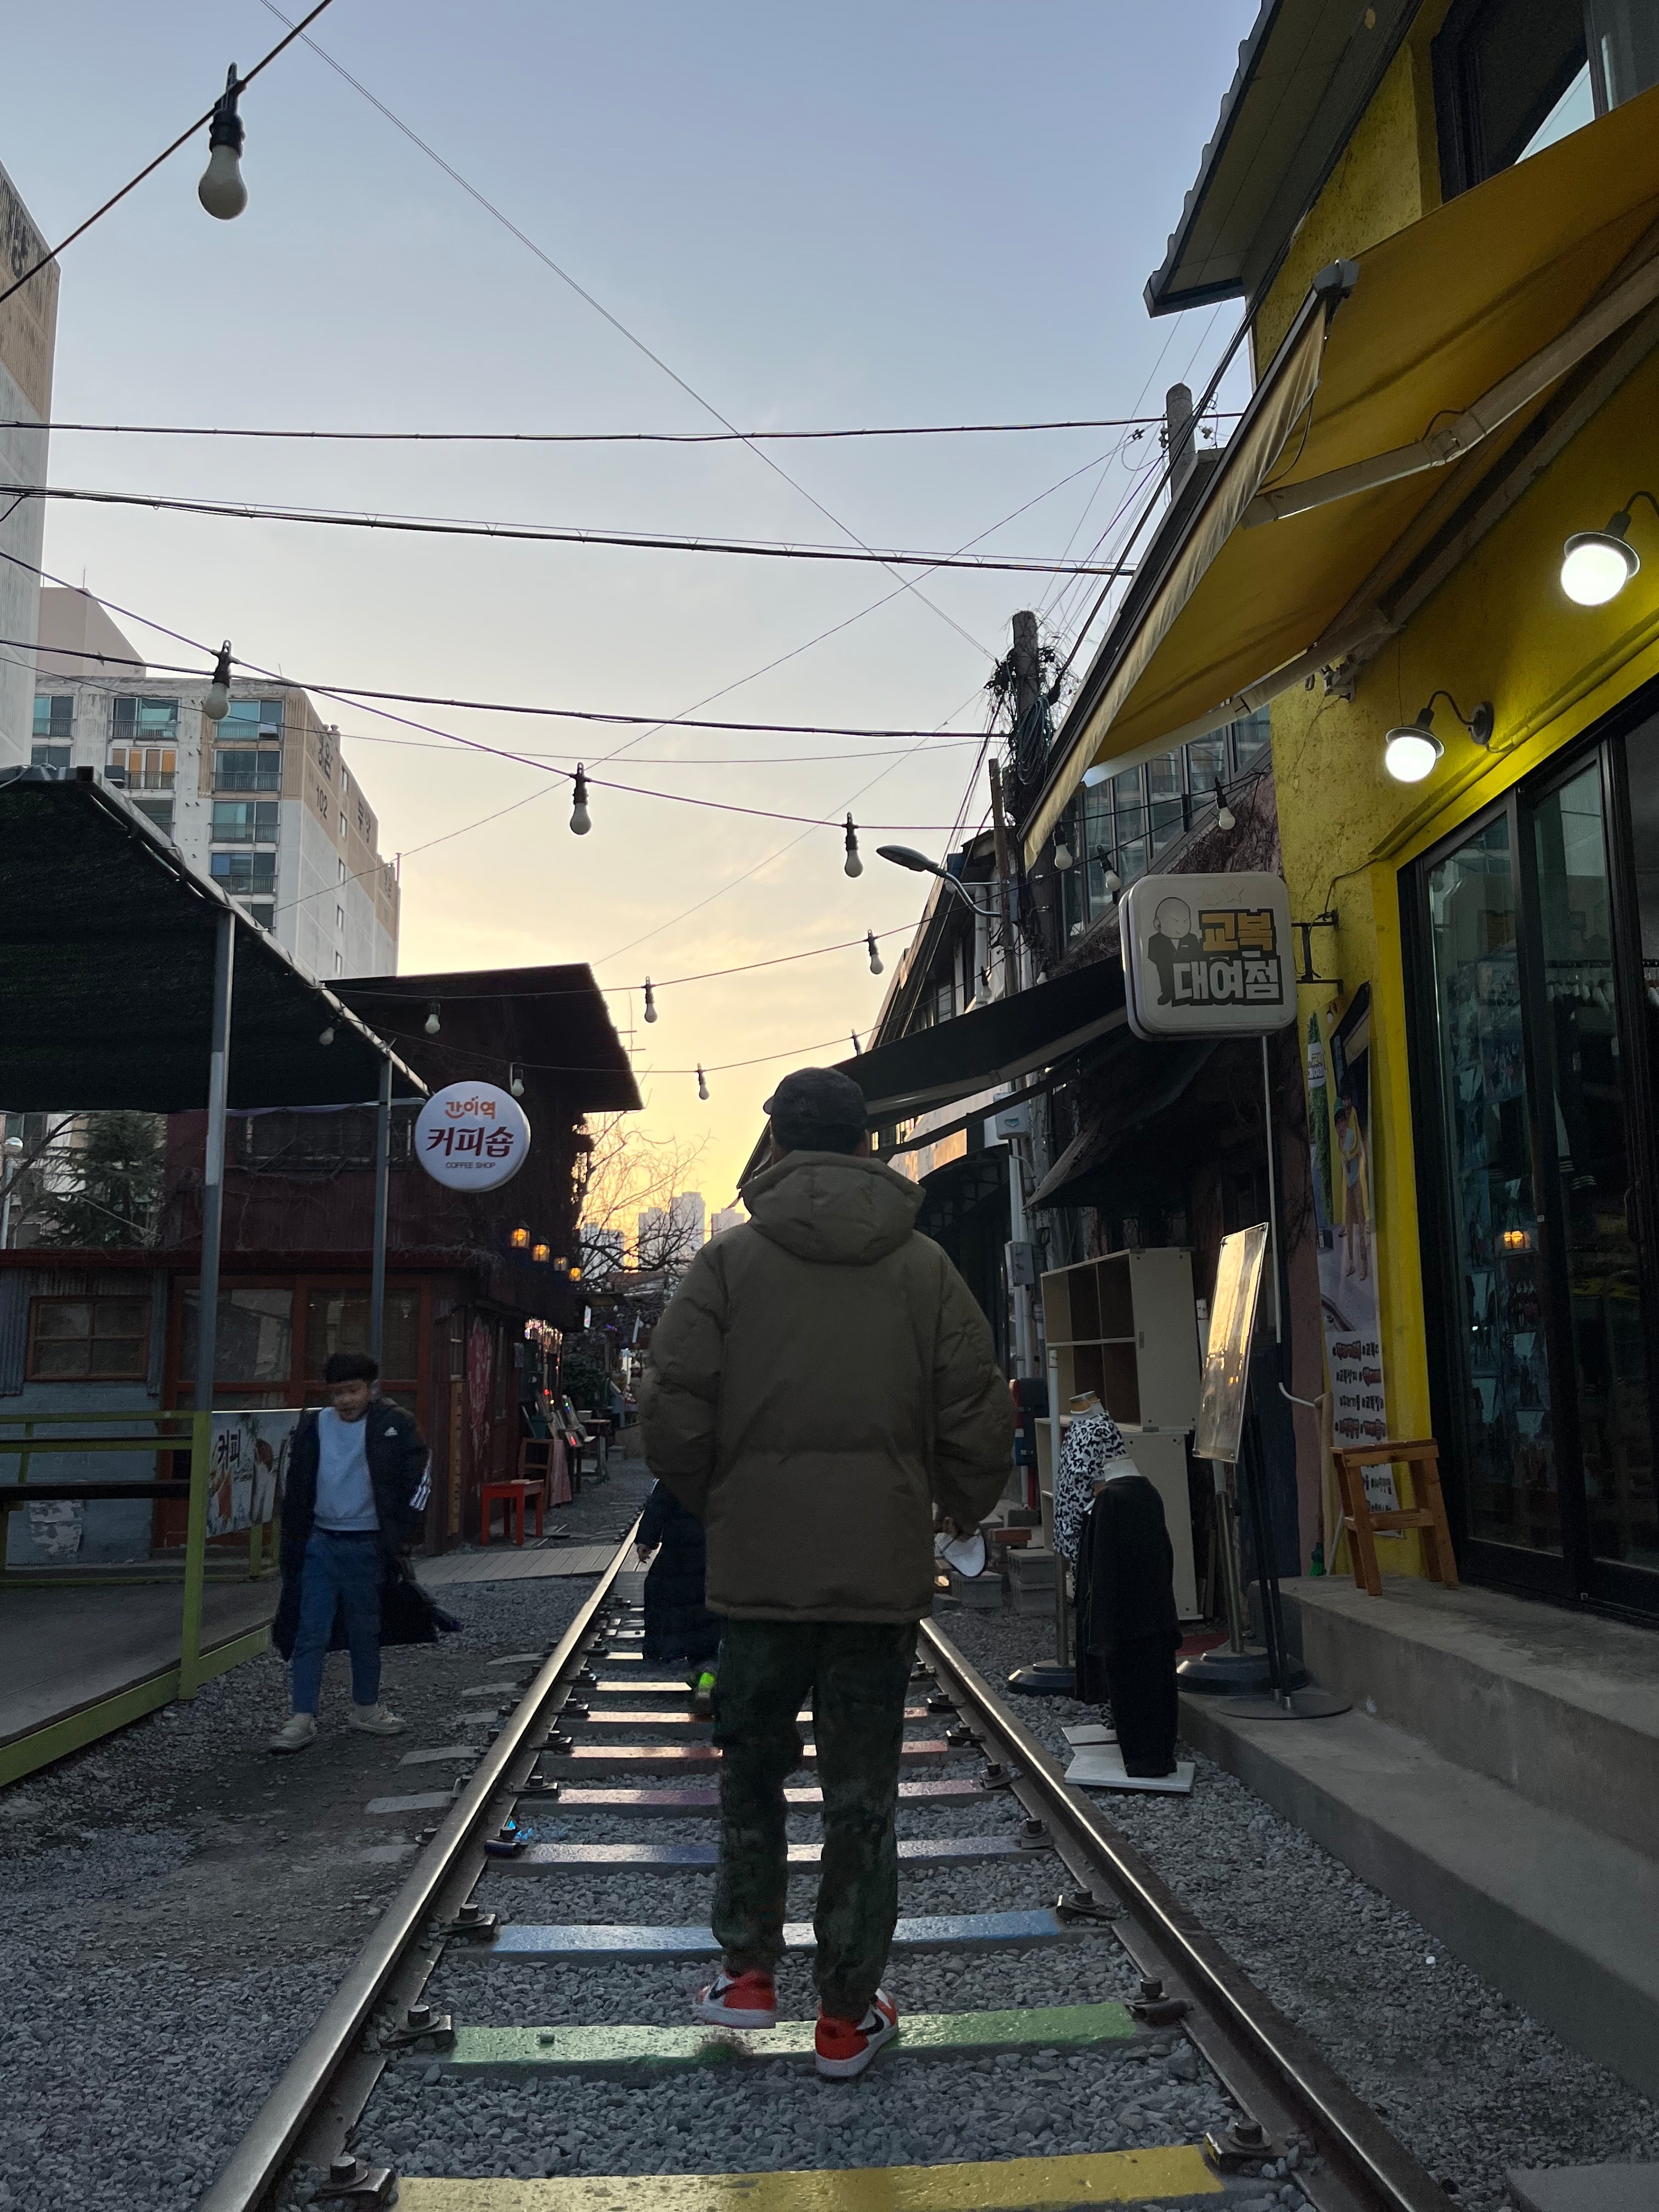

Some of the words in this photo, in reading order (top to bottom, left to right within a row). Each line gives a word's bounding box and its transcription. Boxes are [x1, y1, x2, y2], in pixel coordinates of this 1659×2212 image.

[317, 785, 328, 820] 102
[1201, 912, 1273, 952] 교복
[1172, 952, 1280, 1001] 대여점
[444, 1098, 496, 1120] 간이역
[426, 1126, 514, 1158] 커피숍
[218, 1429, 241, 1470] 커피
